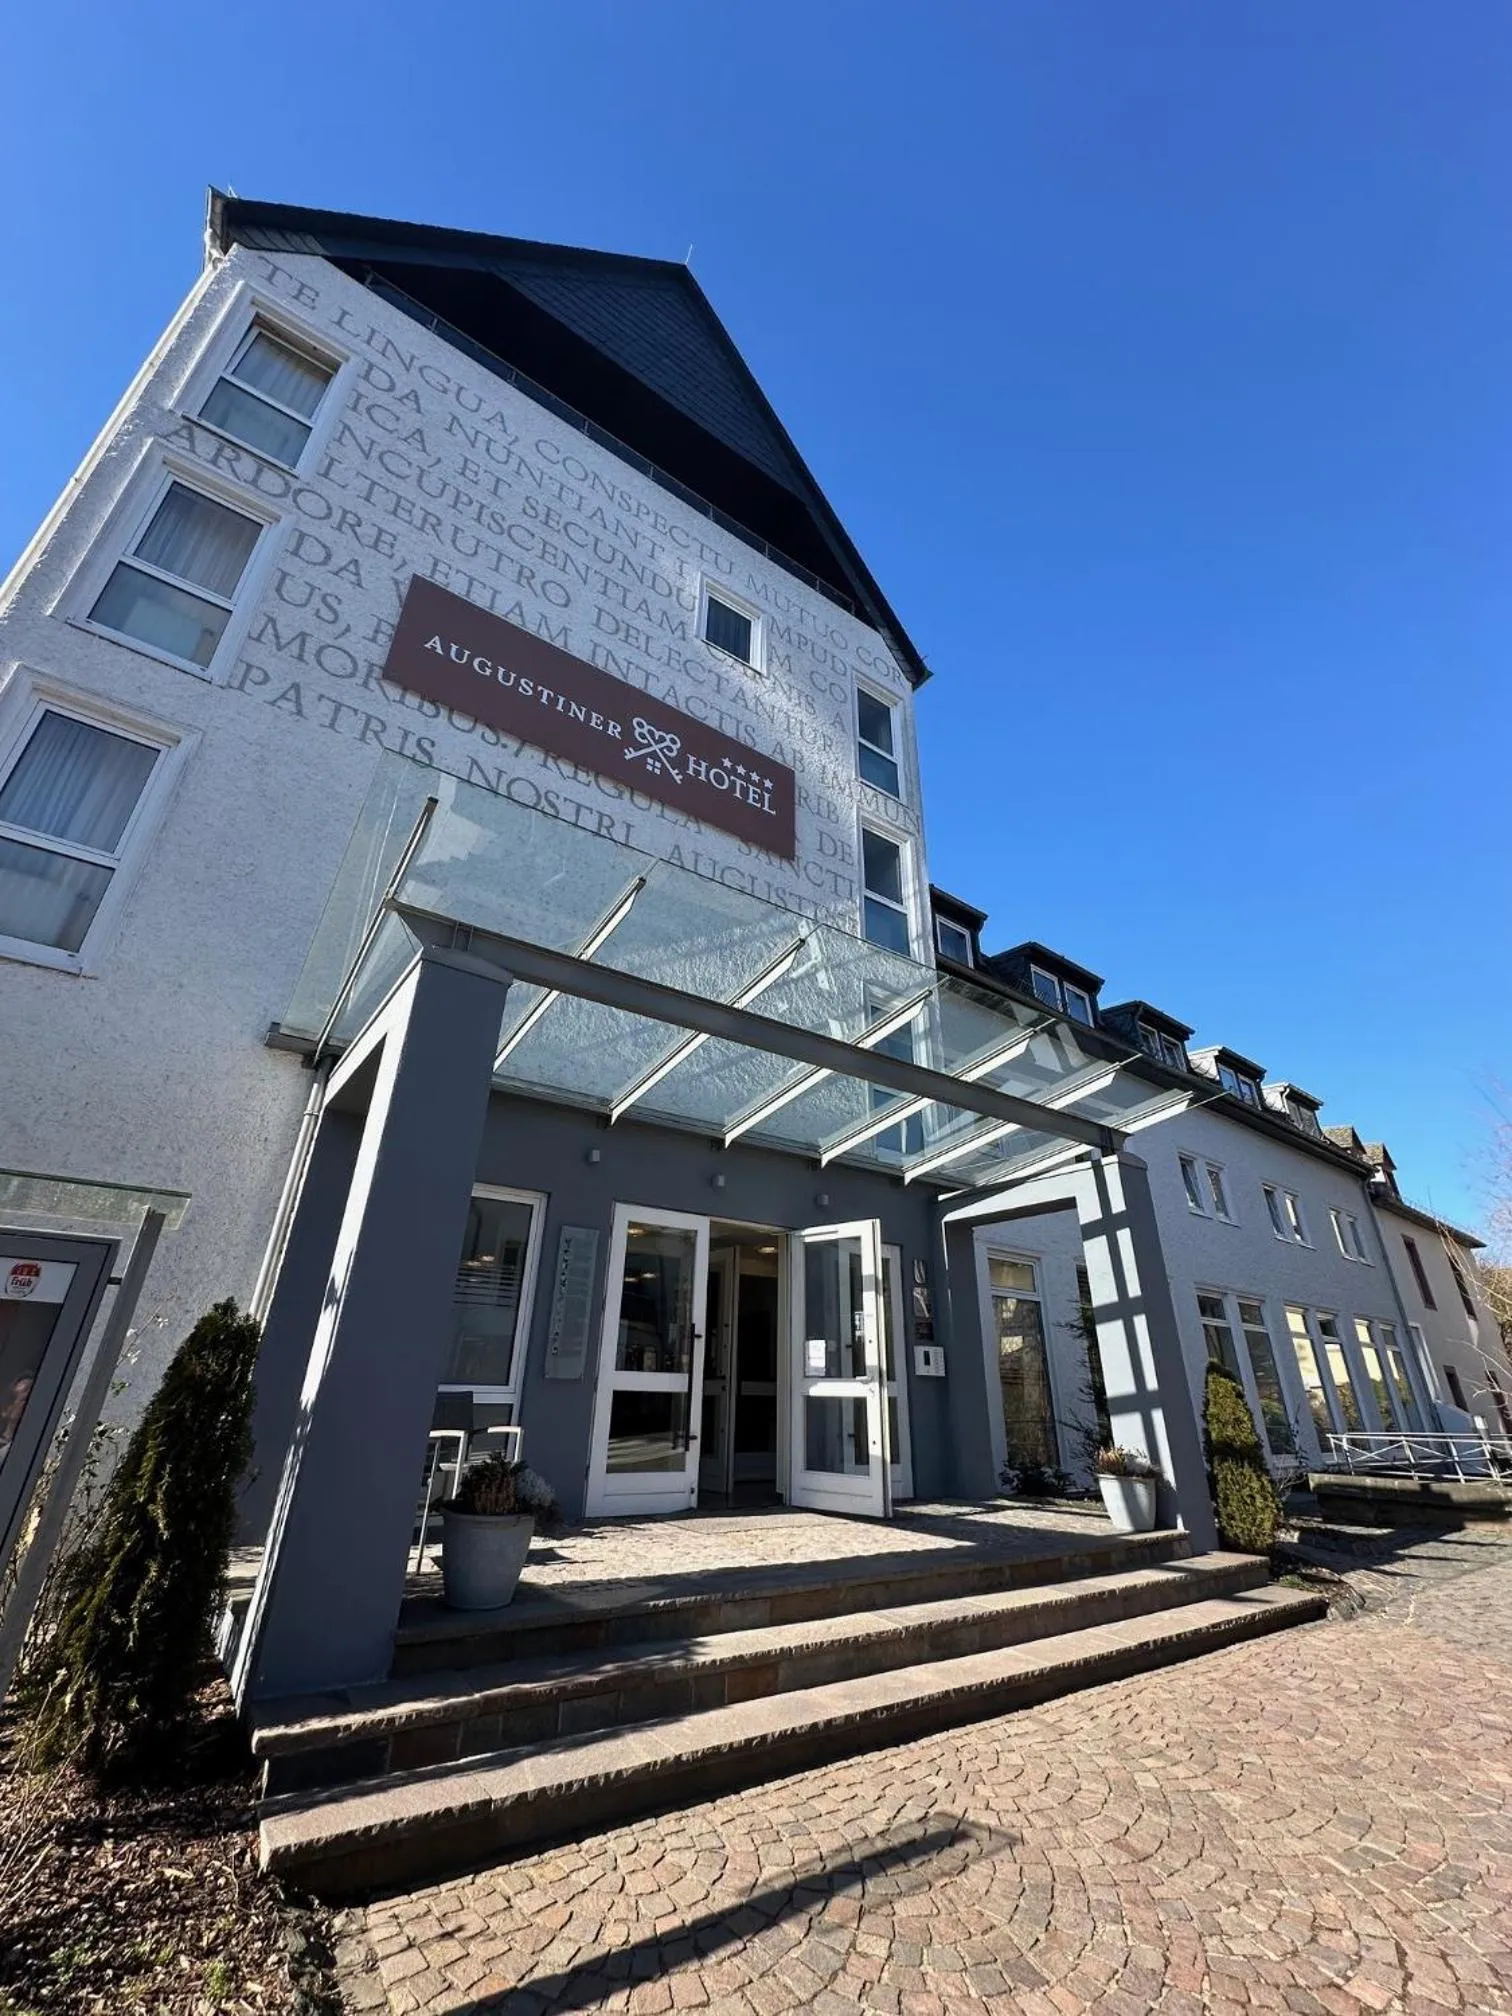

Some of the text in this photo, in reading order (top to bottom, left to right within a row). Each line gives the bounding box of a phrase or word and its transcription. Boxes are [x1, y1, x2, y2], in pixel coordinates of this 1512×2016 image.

[256, 255, 320, 311] TE
[331, 307, 519, 447] LINGUA,
[533, 432, 733, 581] CONSPECTU
[745, 569, 848, 654] MUTUO
[285, 529, 368, 590] DA
[315, 451, 573, 614] LTERUTRO
[330, 418, 687, 644] NCUPISCENTIAM
[830, 707, 847, 735] A
[344, 386, 442, 473] ICA,
[453, 451, 512, 504] ET
[809, 665, 848, 708] CO
[358, 361, 426, 415] DA
[443, 411, 665, 567] NUNTIANT
[163, 424, 408, 572] ARDORE,
[422, 552, 574, 652] ETIAM
[586, 639, 756, 749] INTACTIS
[769, 734, 805, 775] AB
[274, 568, 351, 640] US,
[815, 827, 855, 868] DE
[422, 630, 776, 816] AUGUSTINER HOTEL
[229, 659, 436, 769] PATRIS
[463, 755, 636, 846] NOSTRI
